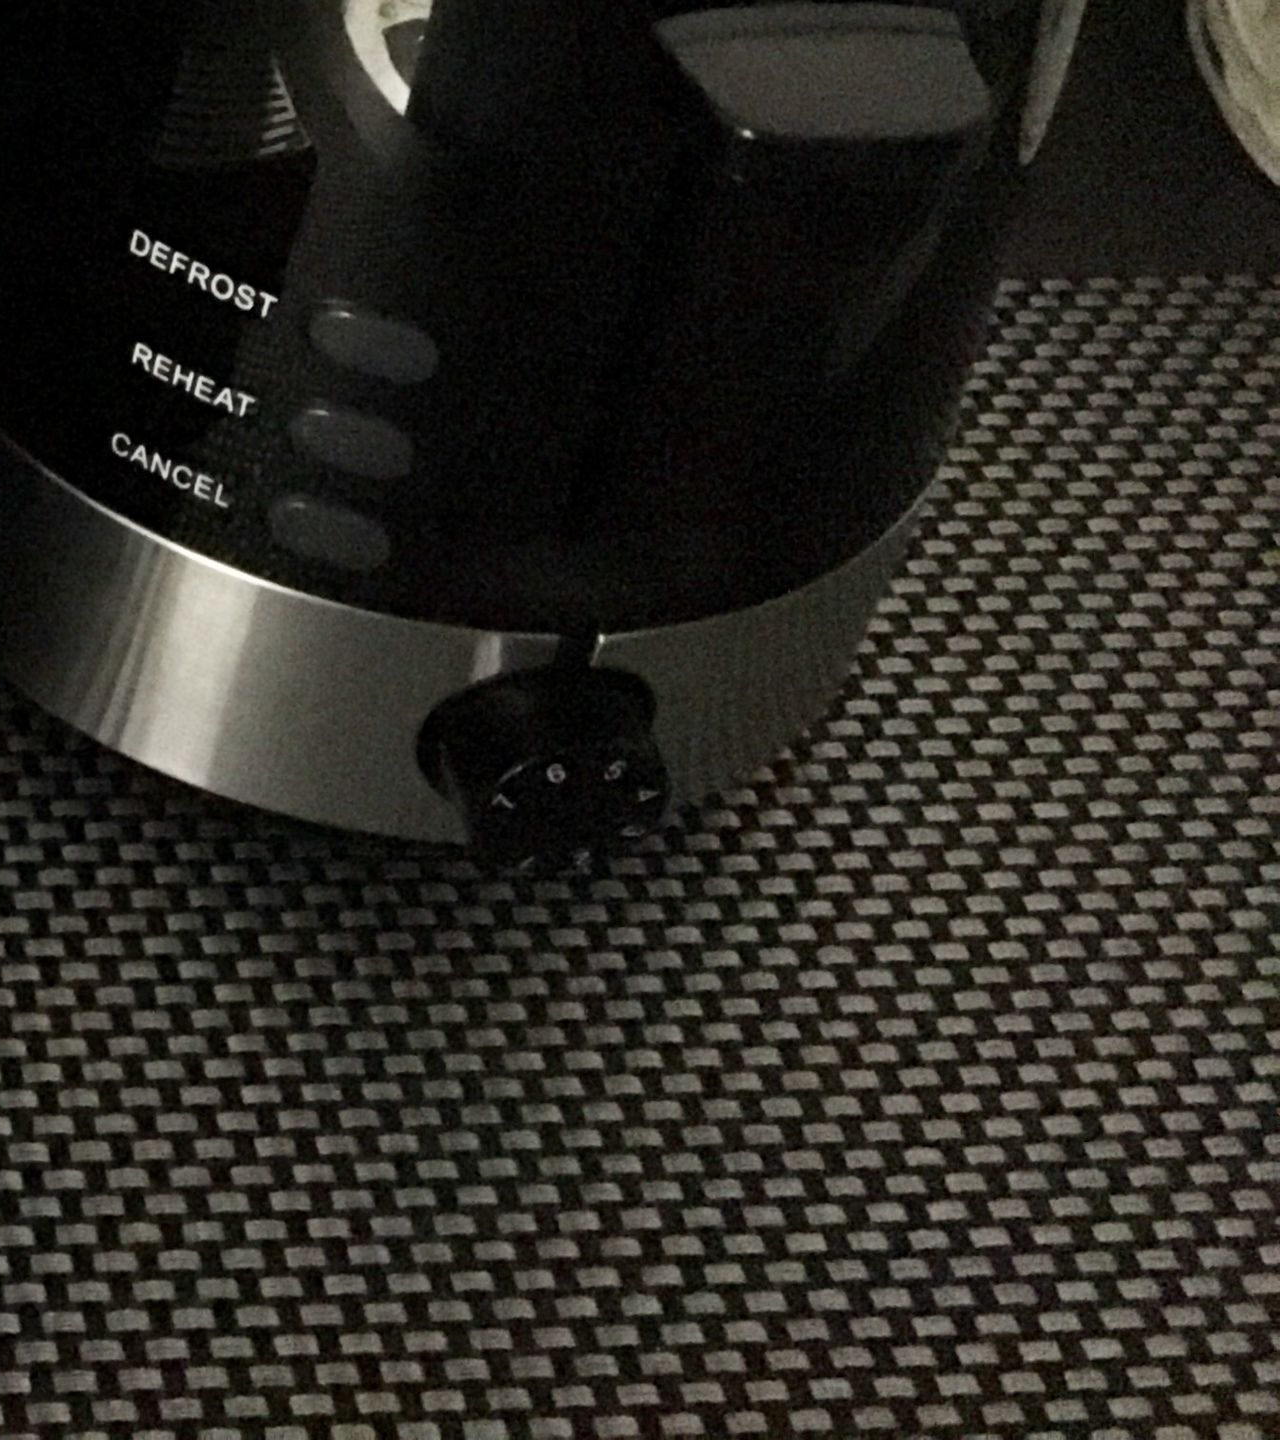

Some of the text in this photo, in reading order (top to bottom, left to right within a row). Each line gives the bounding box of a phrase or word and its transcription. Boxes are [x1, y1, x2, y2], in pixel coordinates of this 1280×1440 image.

[129, 229, 279, 318] DEFROST
[131, 342, 256, 418] REHEAT
[110, 432, 230, 509] CANCEL
